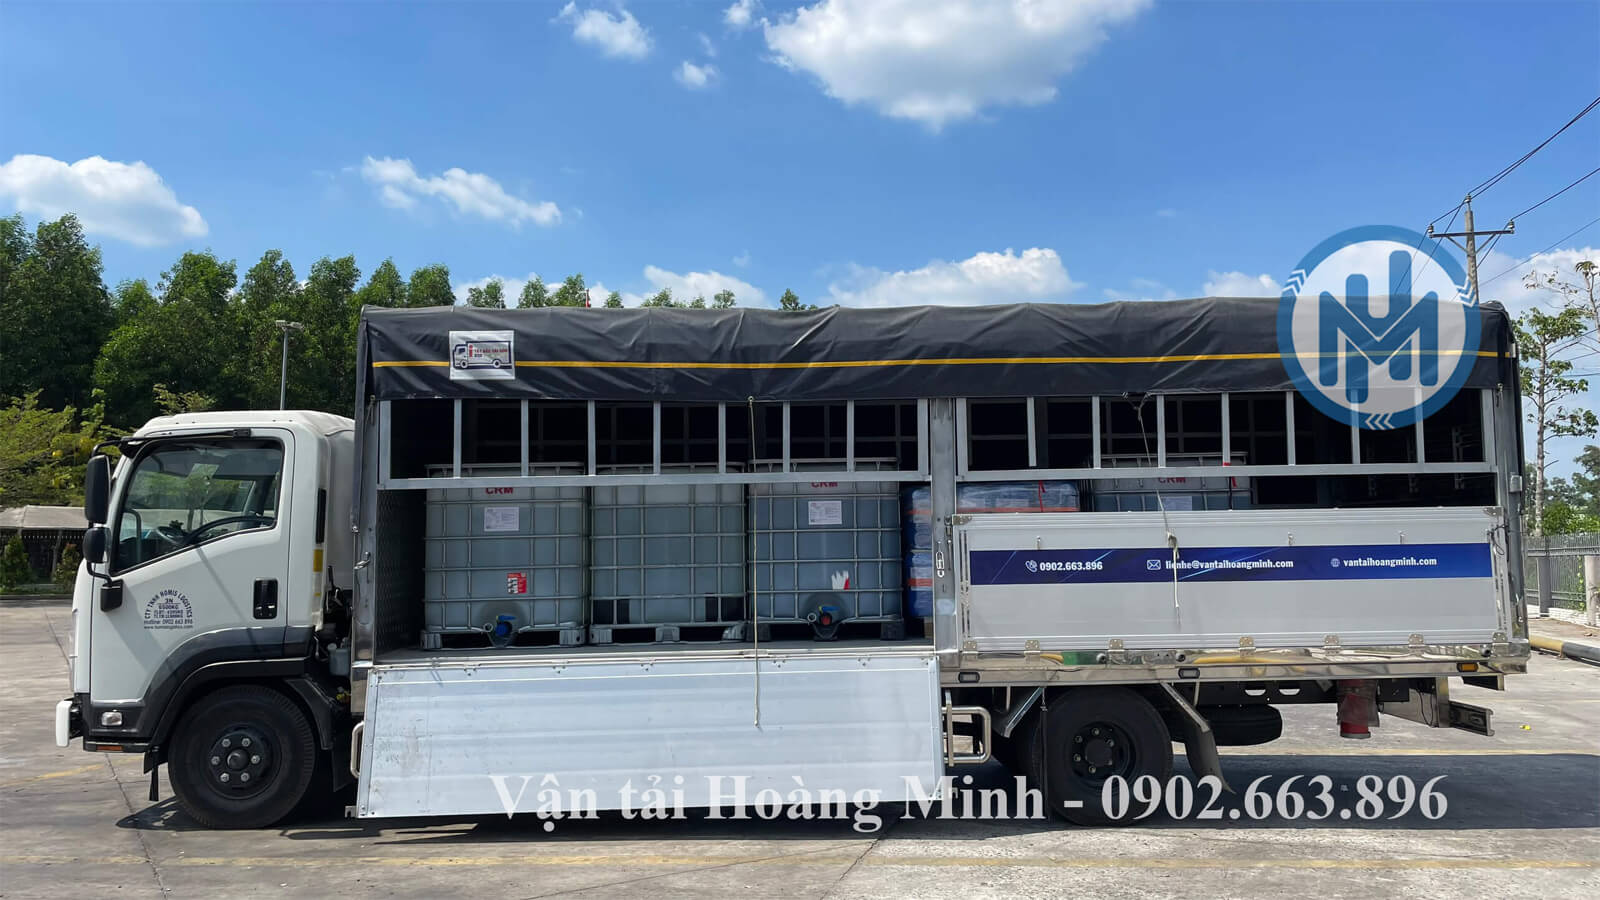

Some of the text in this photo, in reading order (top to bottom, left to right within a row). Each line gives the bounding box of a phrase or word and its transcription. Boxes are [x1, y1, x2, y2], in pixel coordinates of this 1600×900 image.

[1040, 561, 1103, 571] 0902.663.896
[1343, 557, 1437, 567] vantaihoangminh.com
[160, 589, 178, 597] HOMIS
[177, 592, 193, 618] LOGISTICS
